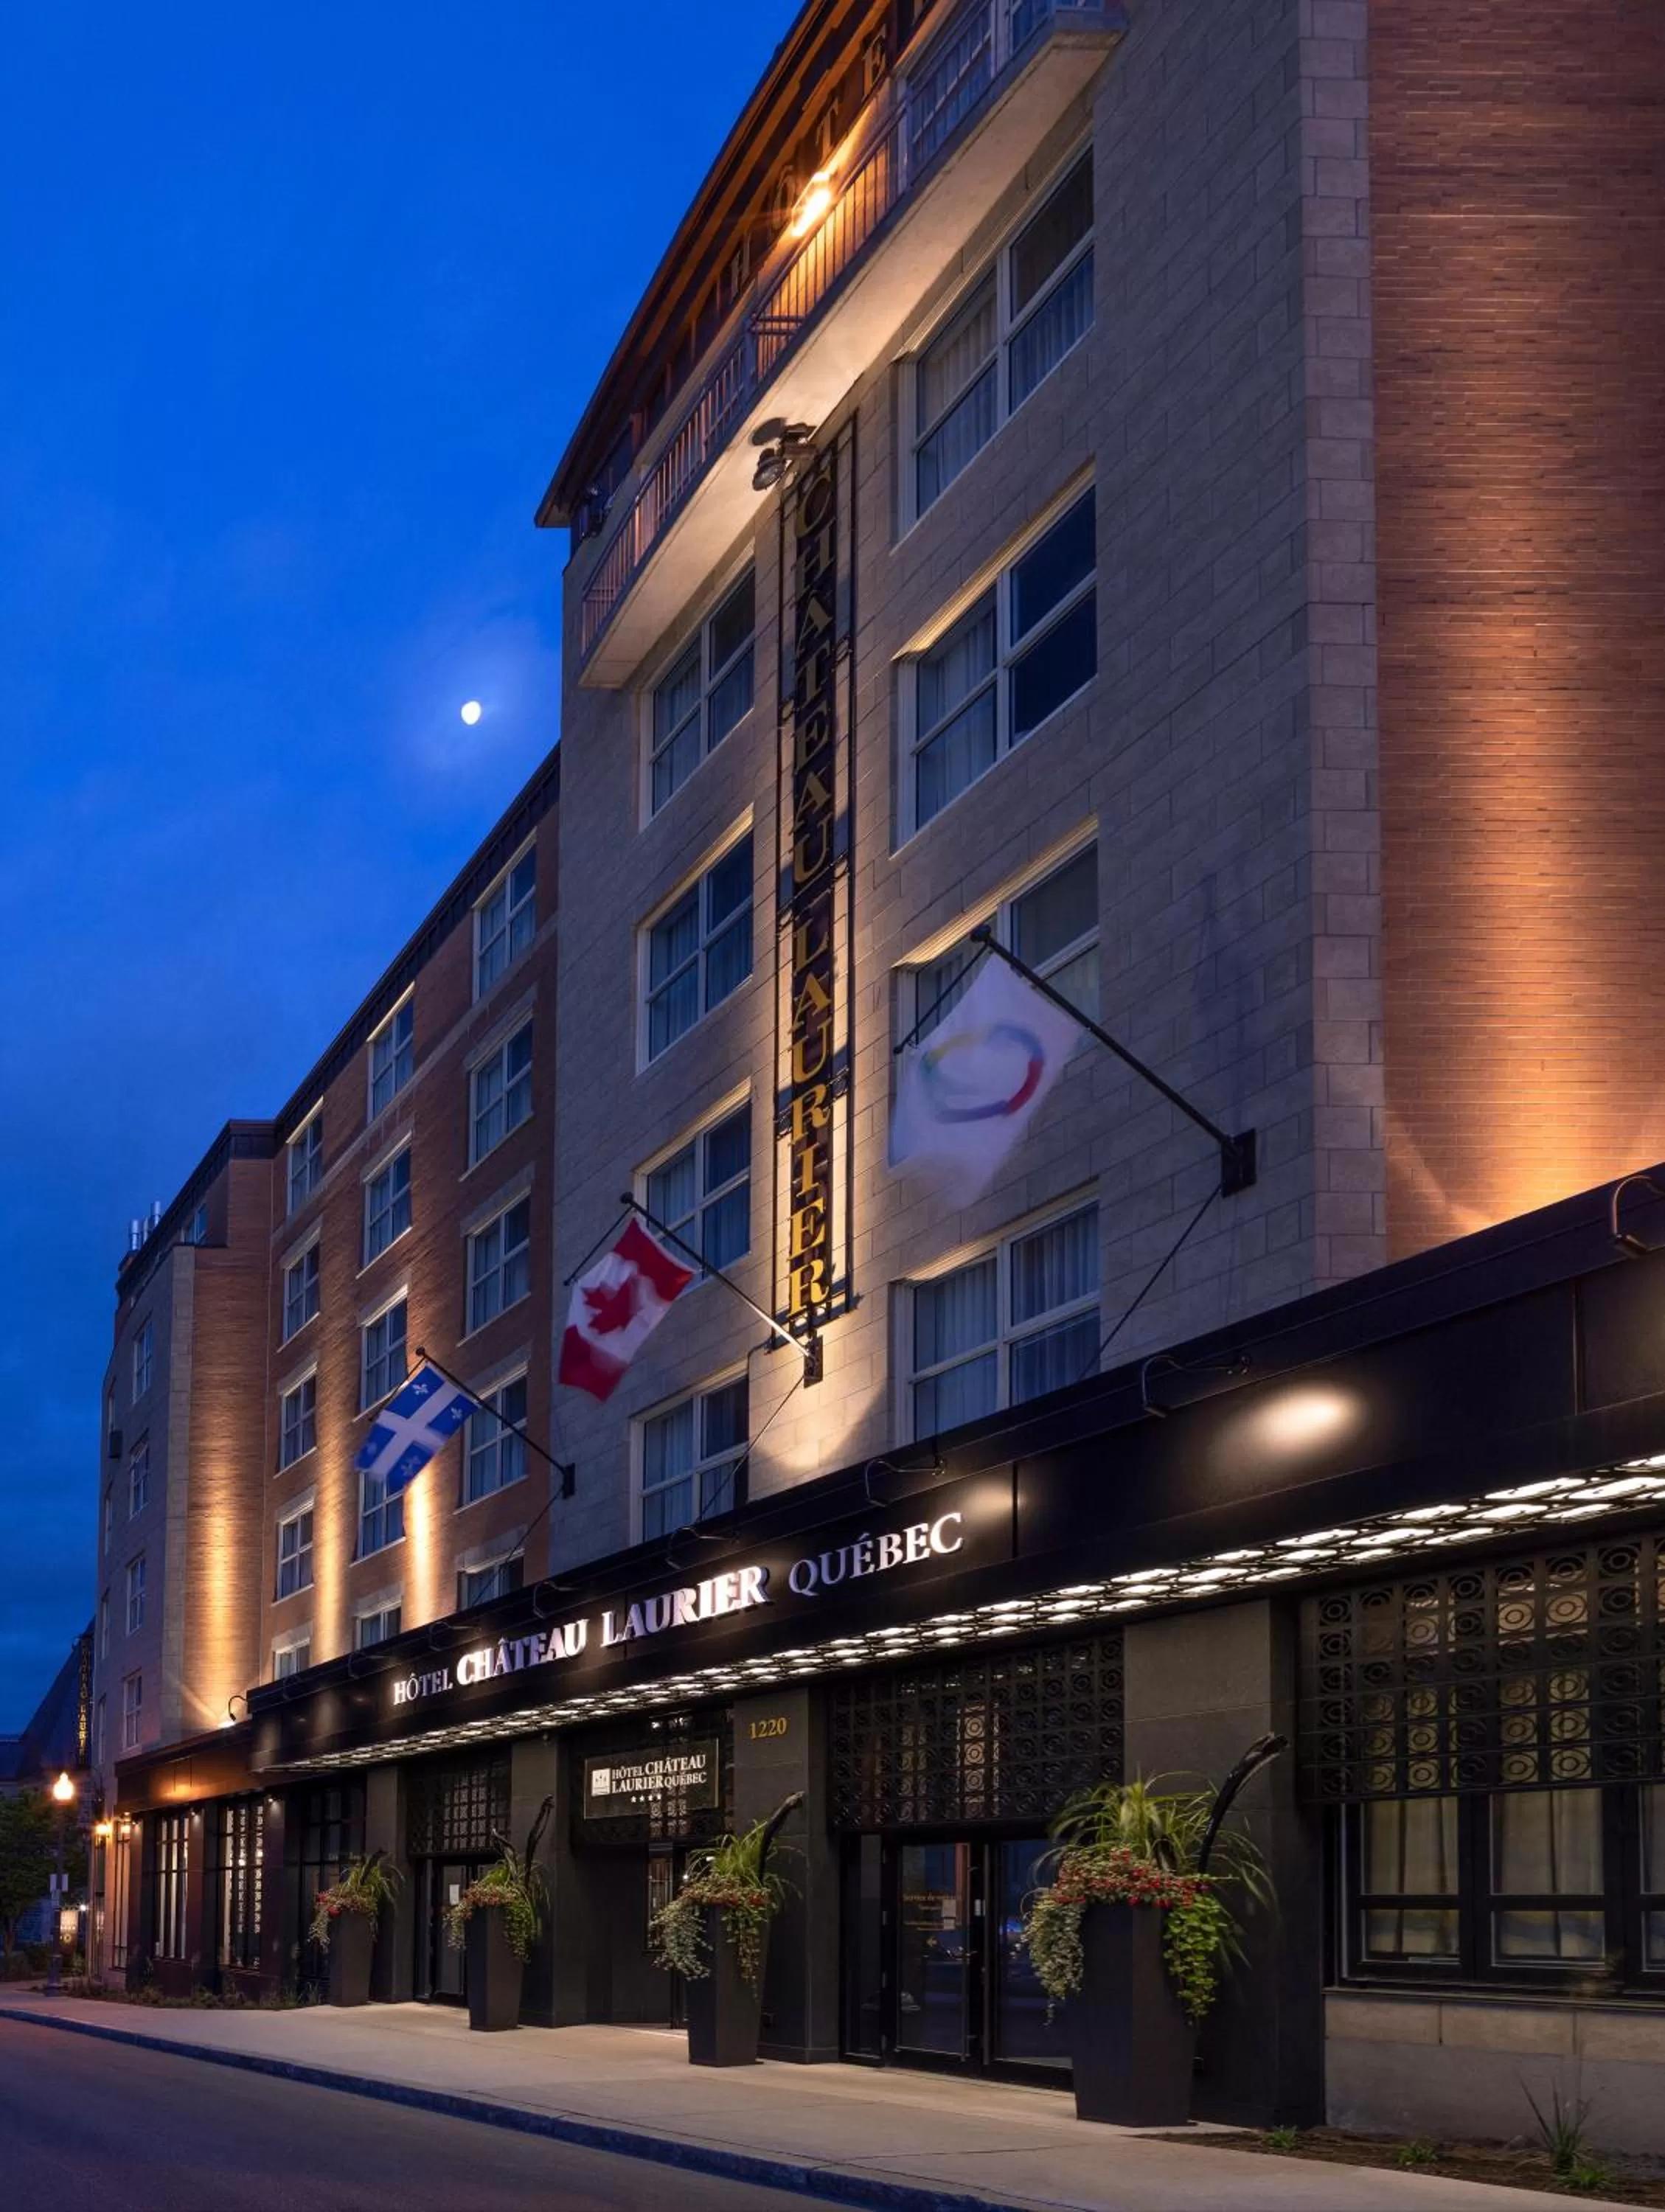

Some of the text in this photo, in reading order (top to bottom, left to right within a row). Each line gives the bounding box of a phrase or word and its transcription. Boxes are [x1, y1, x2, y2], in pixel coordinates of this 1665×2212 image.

[788, 928, 832, 1320] LAURIER
[394, 1512, 964, 1705] HÔTEL CHÂTEAU LAURIER QUÉBEC
[749, 1717, 788, 1739] 1220
[611, 1774, 664, 1794] LAURIER
